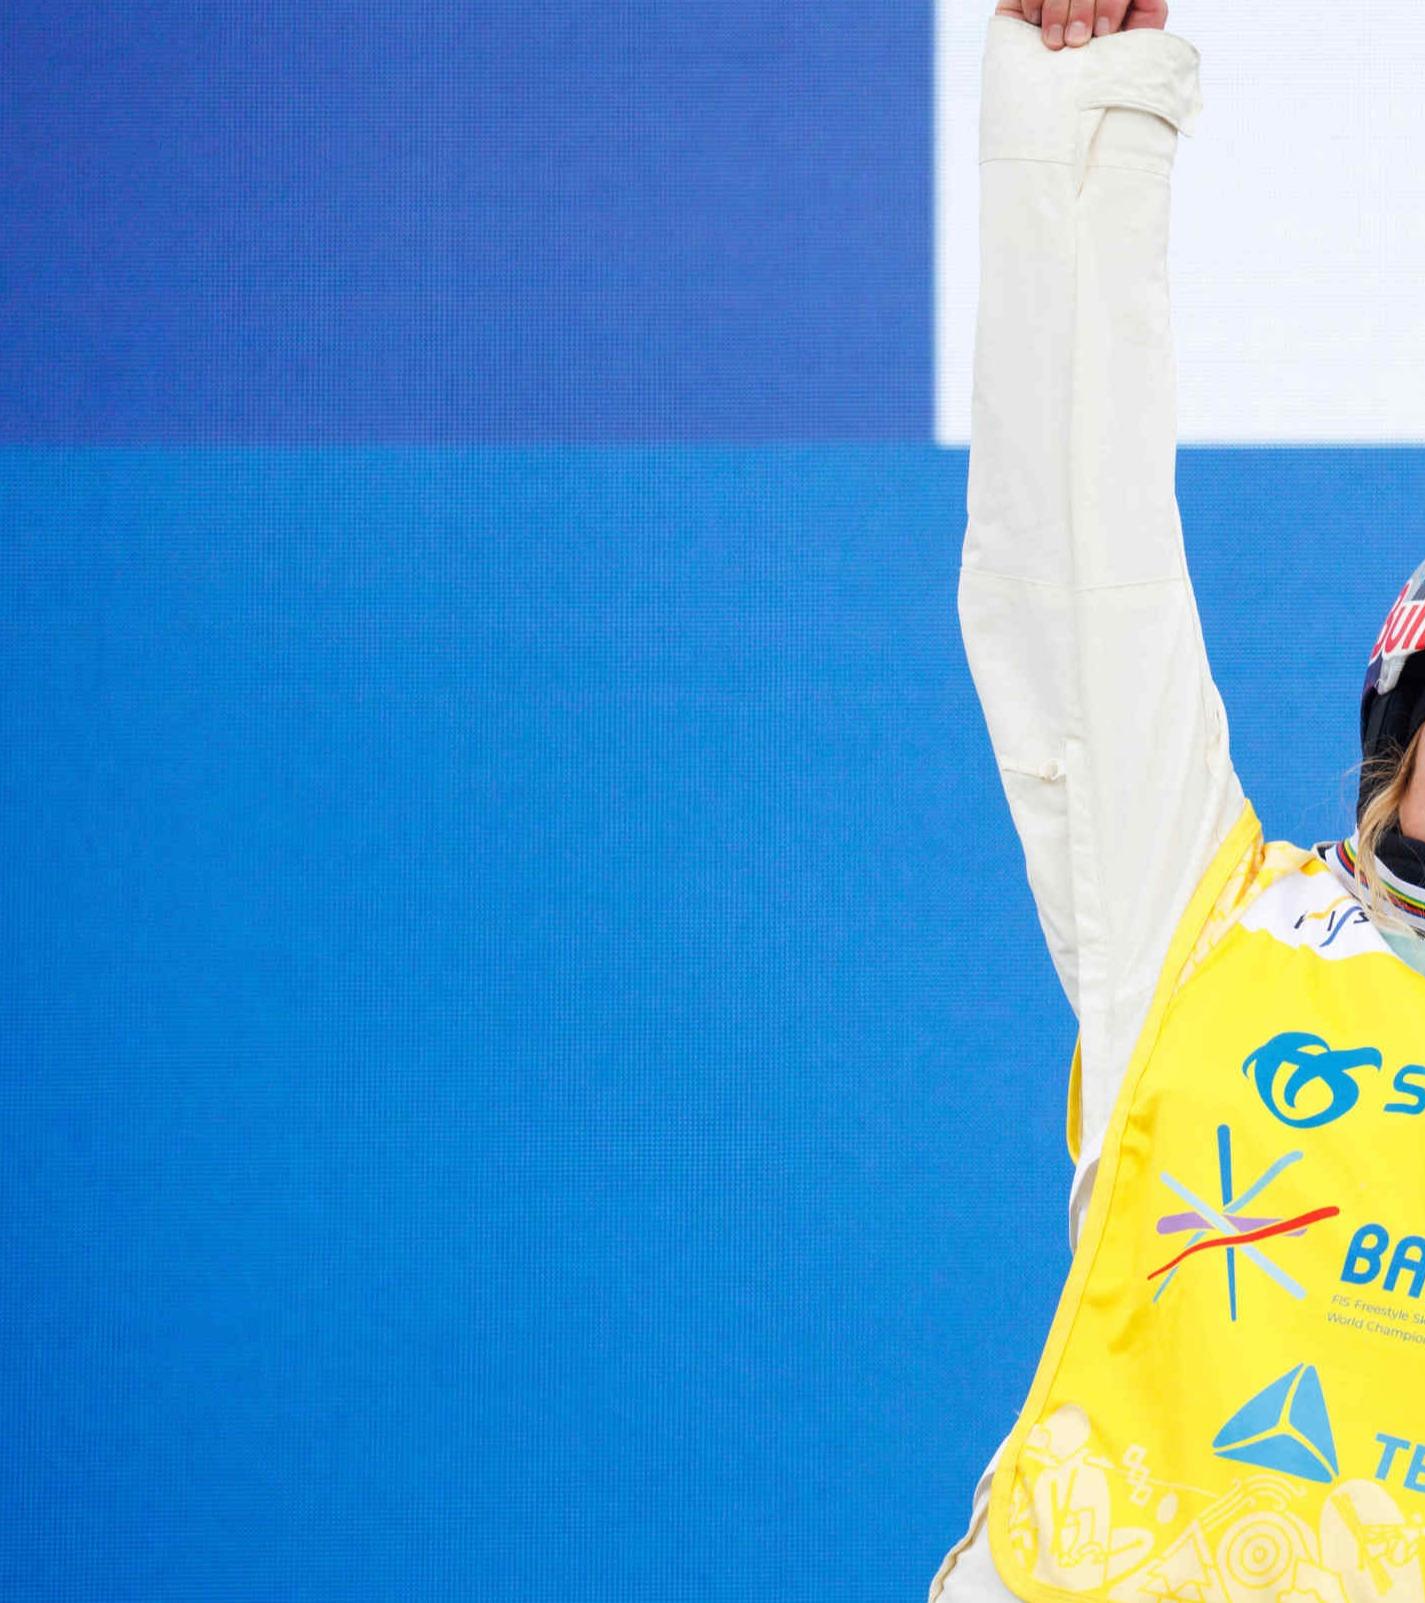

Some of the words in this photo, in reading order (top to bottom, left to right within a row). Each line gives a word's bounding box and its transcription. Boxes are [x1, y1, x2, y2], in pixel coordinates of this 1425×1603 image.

[1331, 1294, 1351, 1308] FIS
[1354, 1299, 1410, 1323] Freestyle
[1327, 1311, 1364, 1331] World
